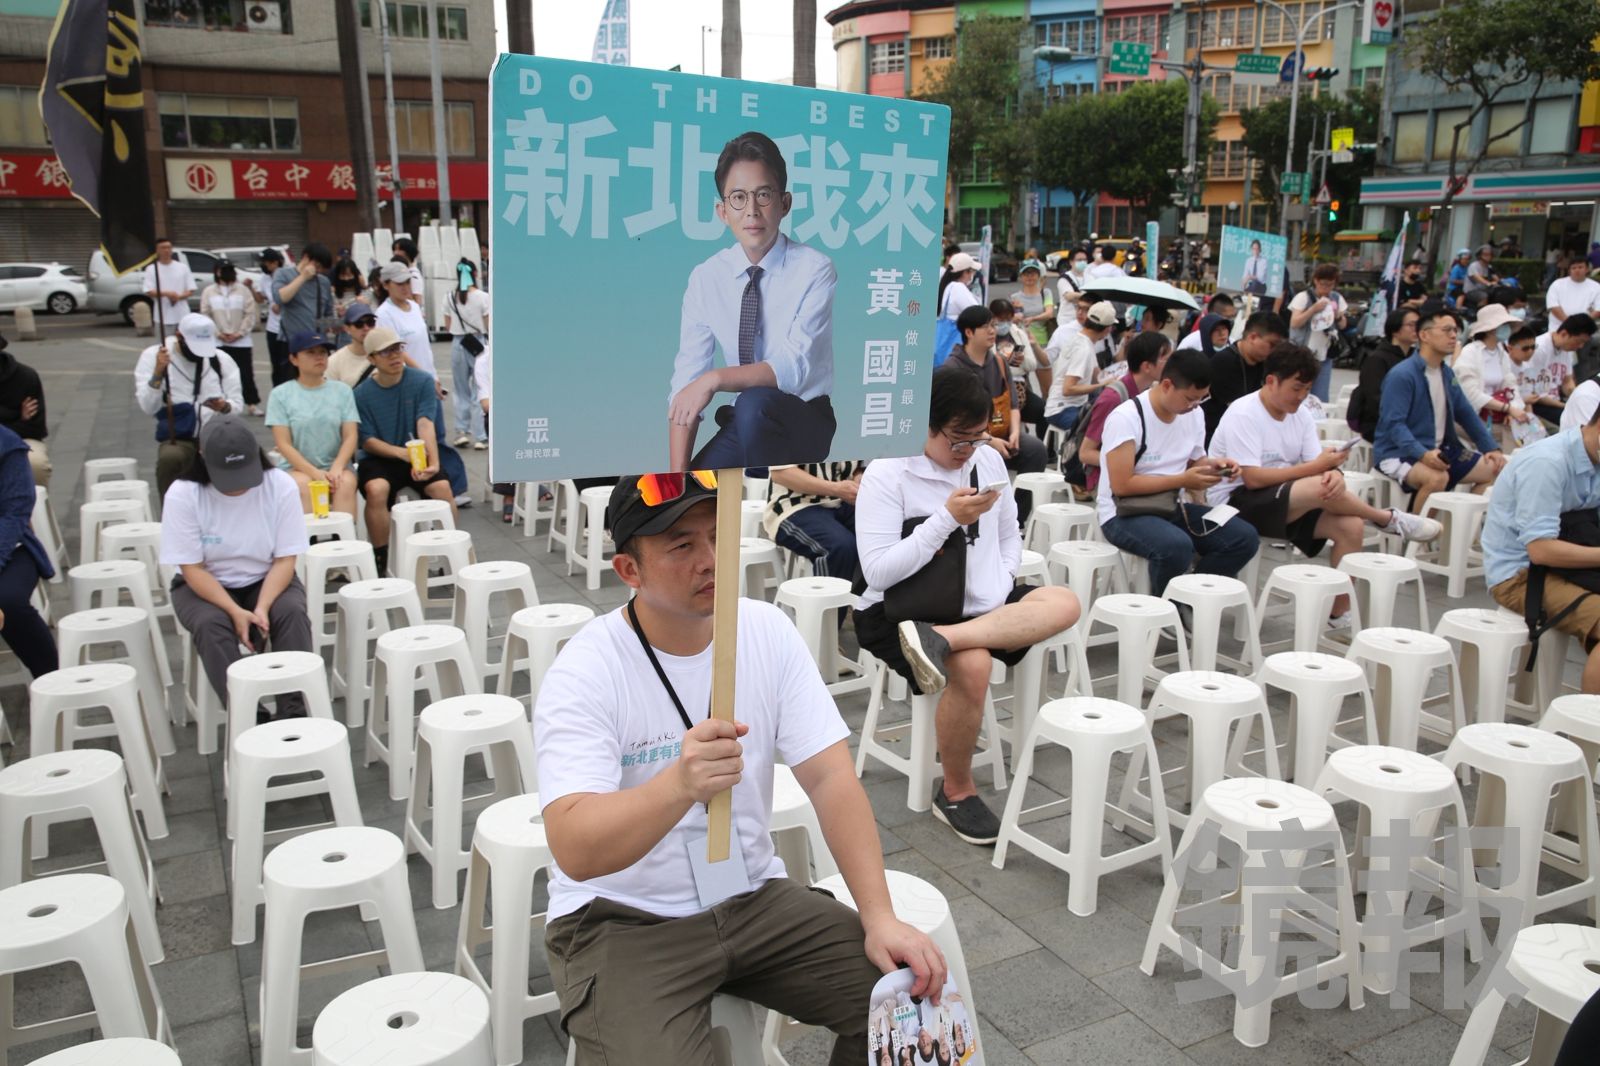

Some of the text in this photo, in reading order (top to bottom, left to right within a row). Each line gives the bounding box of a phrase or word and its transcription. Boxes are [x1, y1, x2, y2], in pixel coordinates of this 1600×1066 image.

[502, 107, 939, 252] 新北我來
[519, 68, 935, 136] DO THE BEST
[861, 268, 905, 438] 黃國昌
[899, 269, 923, 435] 為你做到最好
